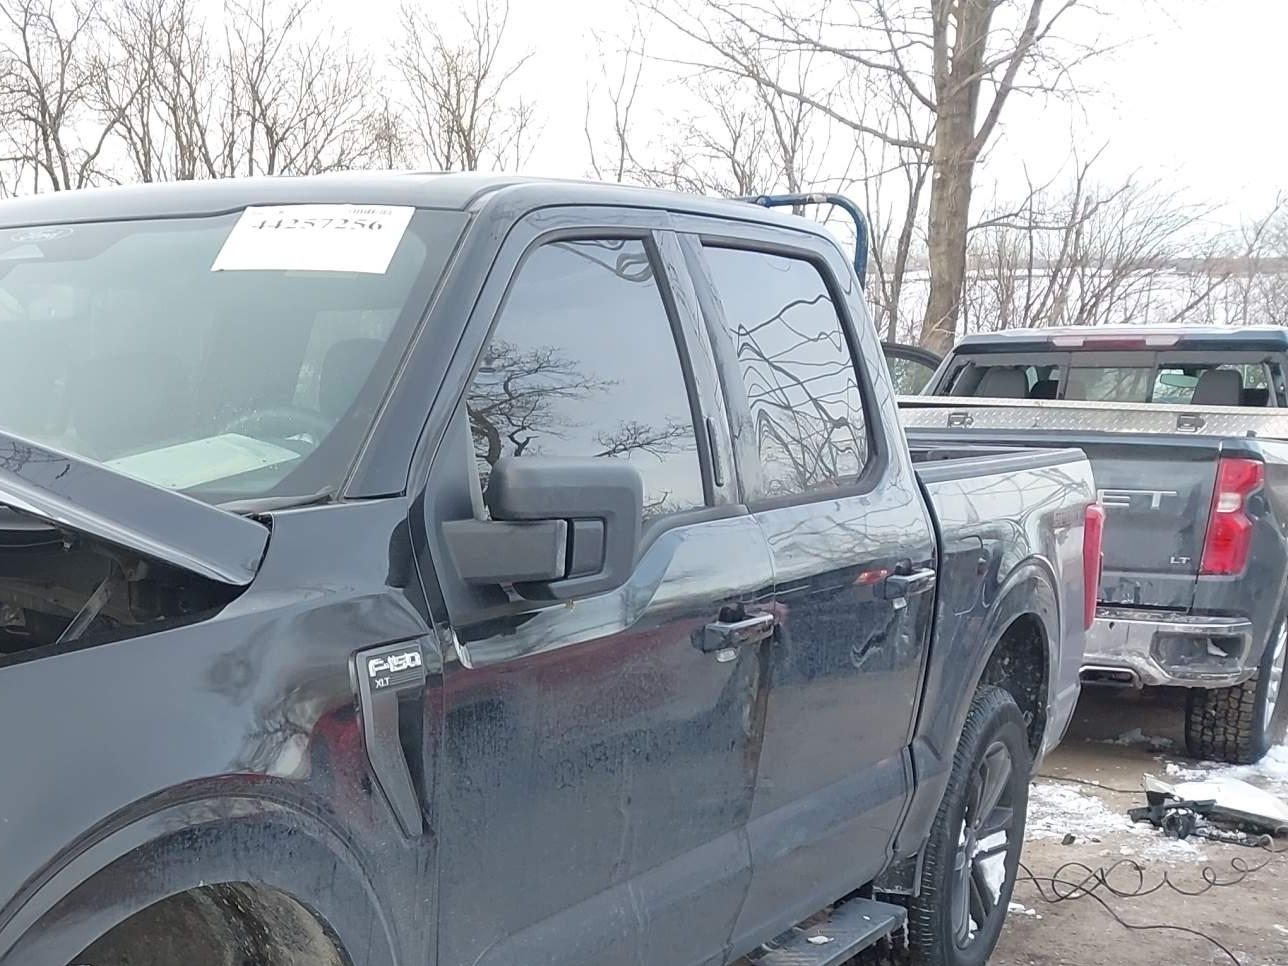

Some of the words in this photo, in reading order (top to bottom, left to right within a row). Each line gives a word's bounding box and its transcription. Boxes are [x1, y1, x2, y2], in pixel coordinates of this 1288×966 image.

[1170, 556, 1191, 564] LT
[368, 652, 422, 677] F-150
[375, 677, 390, 689] XLT
